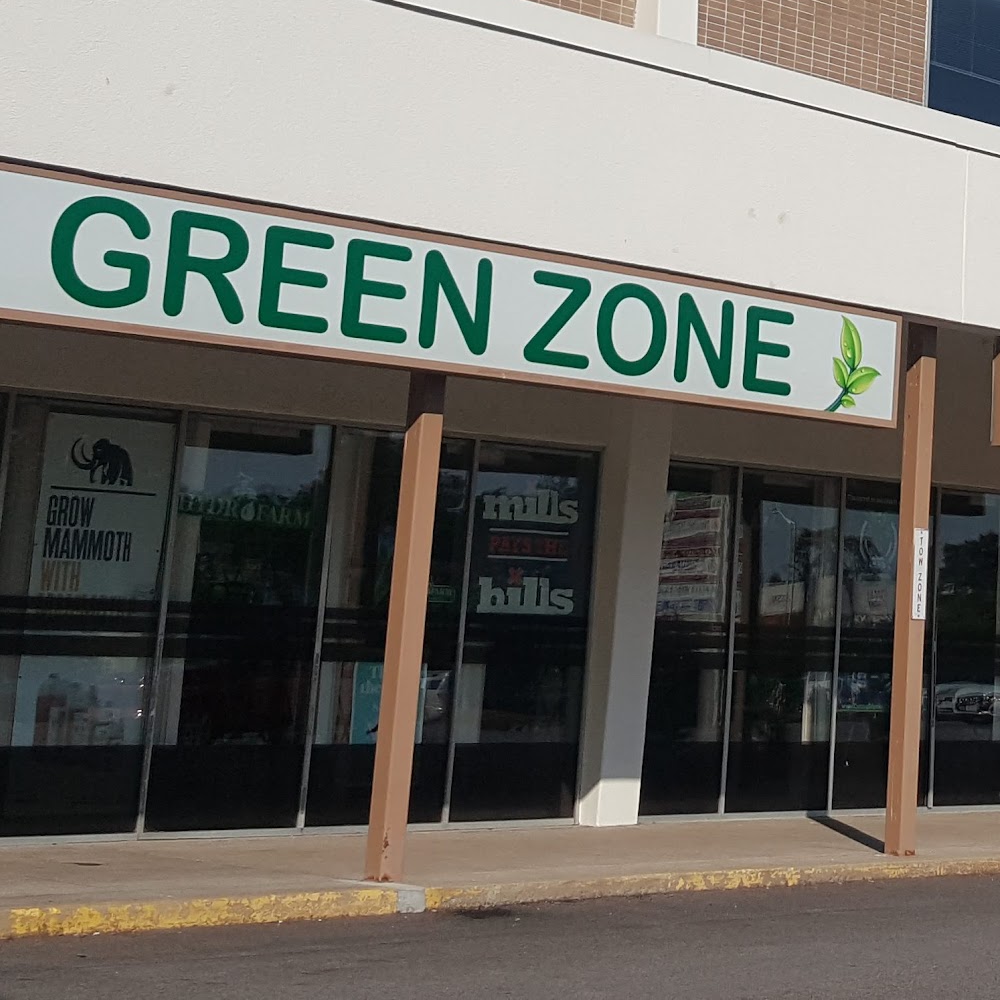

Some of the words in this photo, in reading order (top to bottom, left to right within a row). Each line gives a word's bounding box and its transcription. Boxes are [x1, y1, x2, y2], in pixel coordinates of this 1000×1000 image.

[51, 195, 493, 356] GREEN
[523, 270, 795, 396] ZONE
[46, 494, 96, 528] GROW
[483, 489, 579, 525] mills
[42, 526, 132, 562] MAMMOTH
[41, 560, 81, 592] WITH
[476, 568, 574, 616] bills
